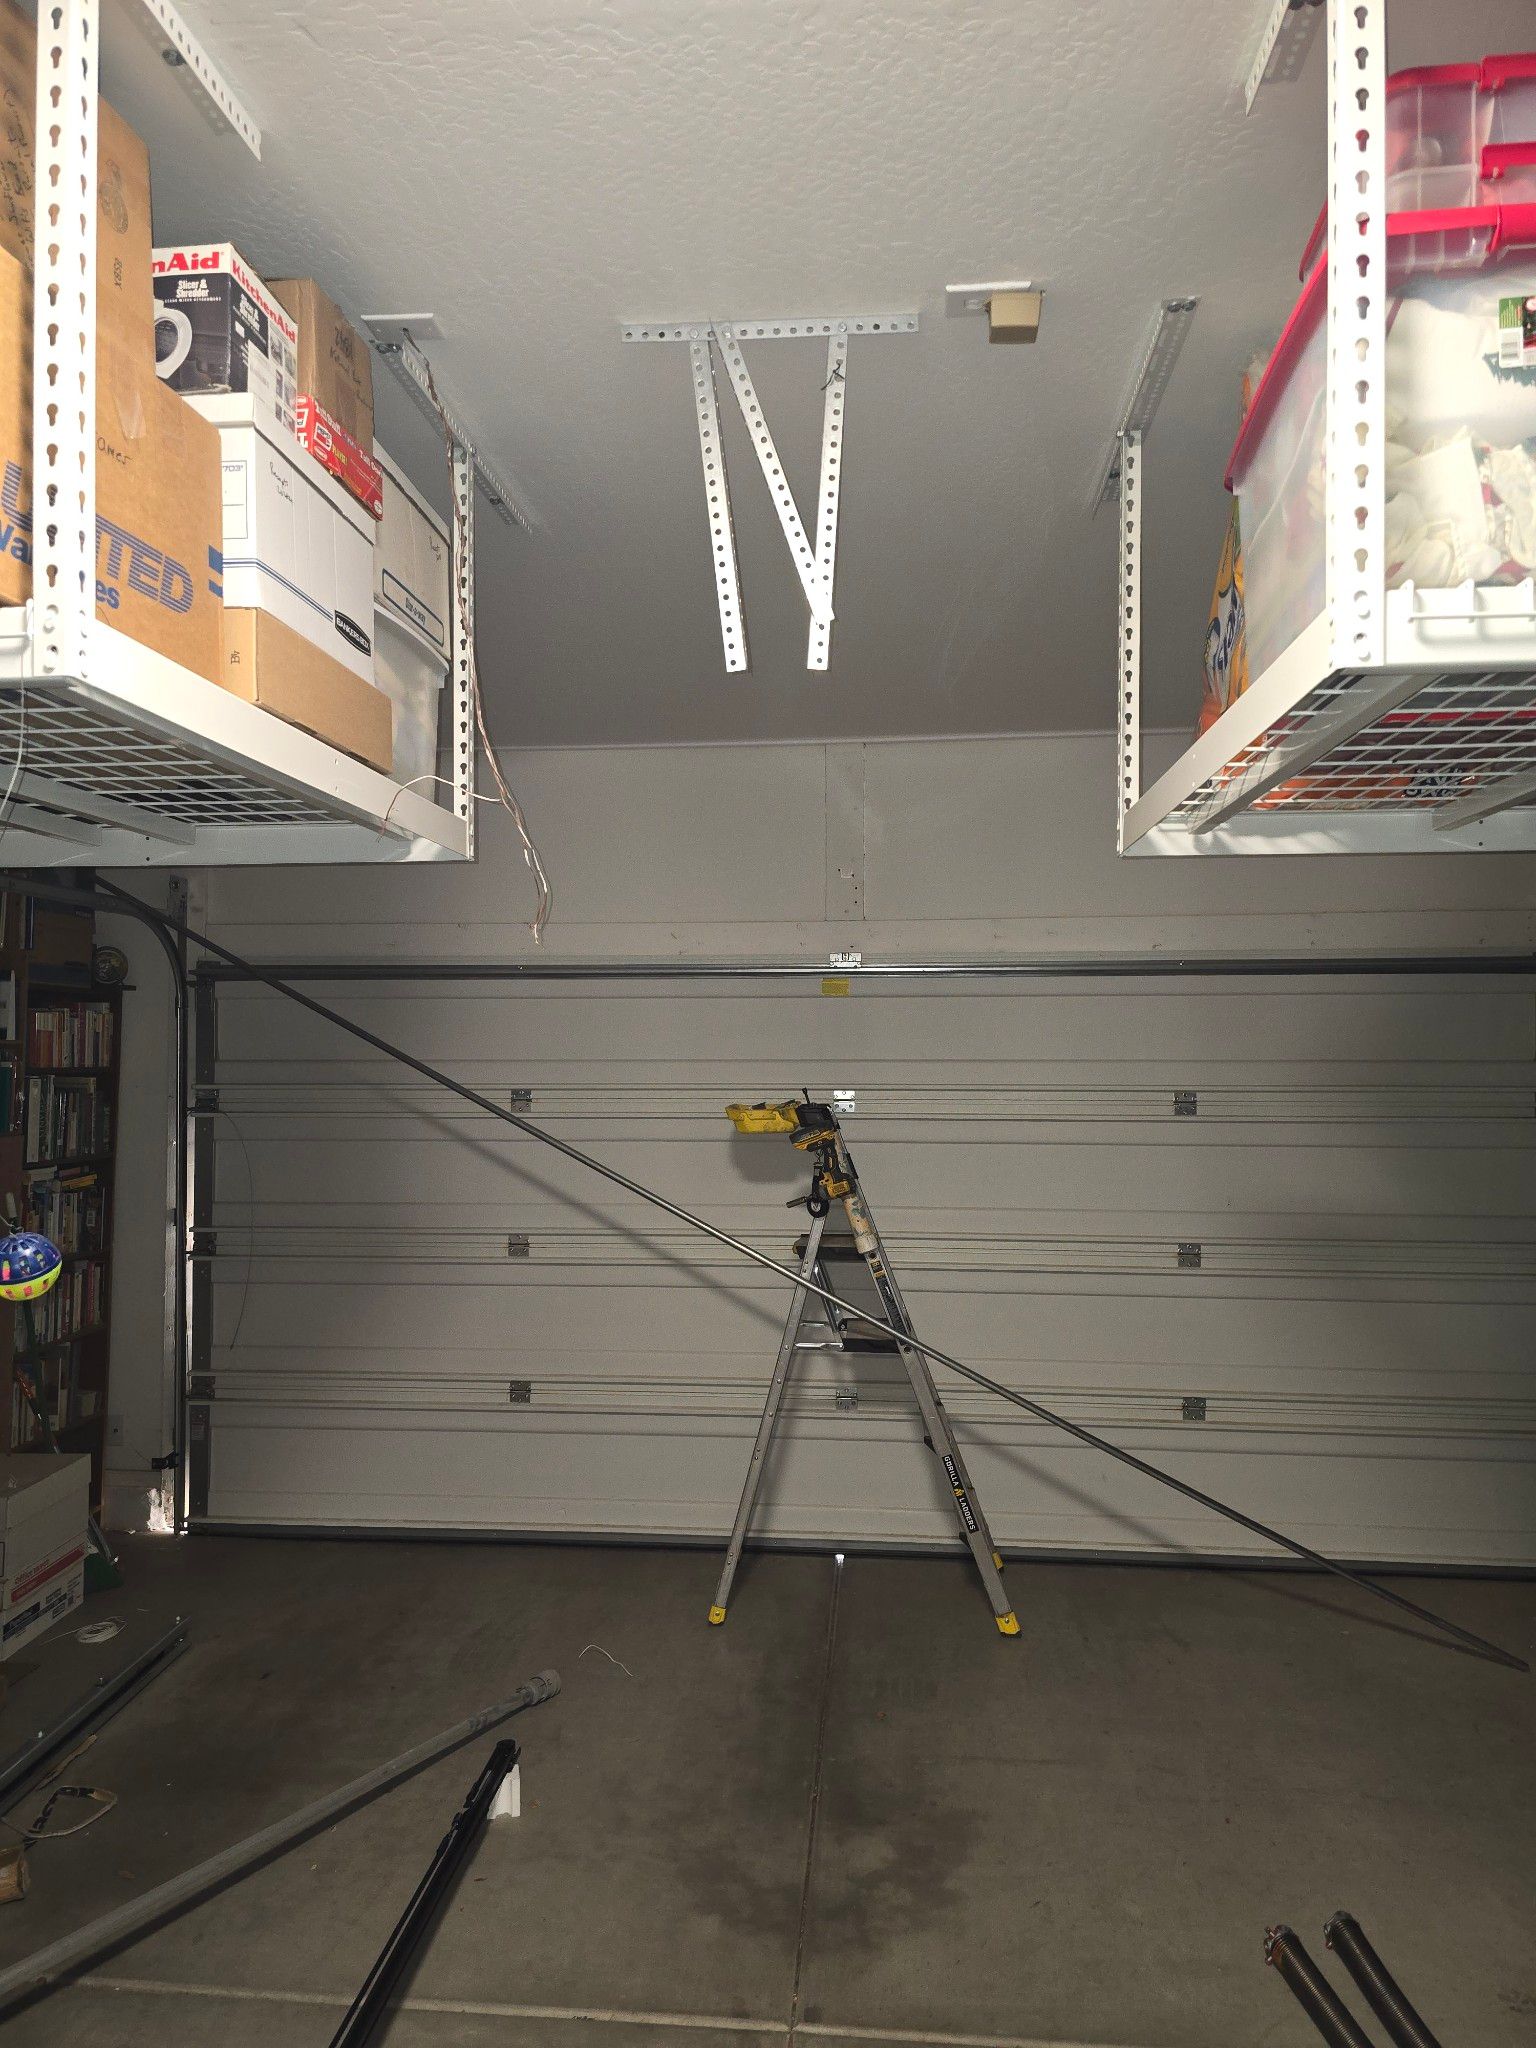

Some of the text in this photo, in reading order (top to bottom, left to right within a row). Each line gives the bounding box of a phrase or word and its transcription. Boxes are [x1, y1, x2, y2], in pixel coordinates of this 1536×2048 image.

[152, 251, 220, 274] nAid
[232, 258, 296, 345] KitchenAid
[944, 1456, 959, 1487] GORILLA
[959, 1497, 976, 1531] LADDERS
